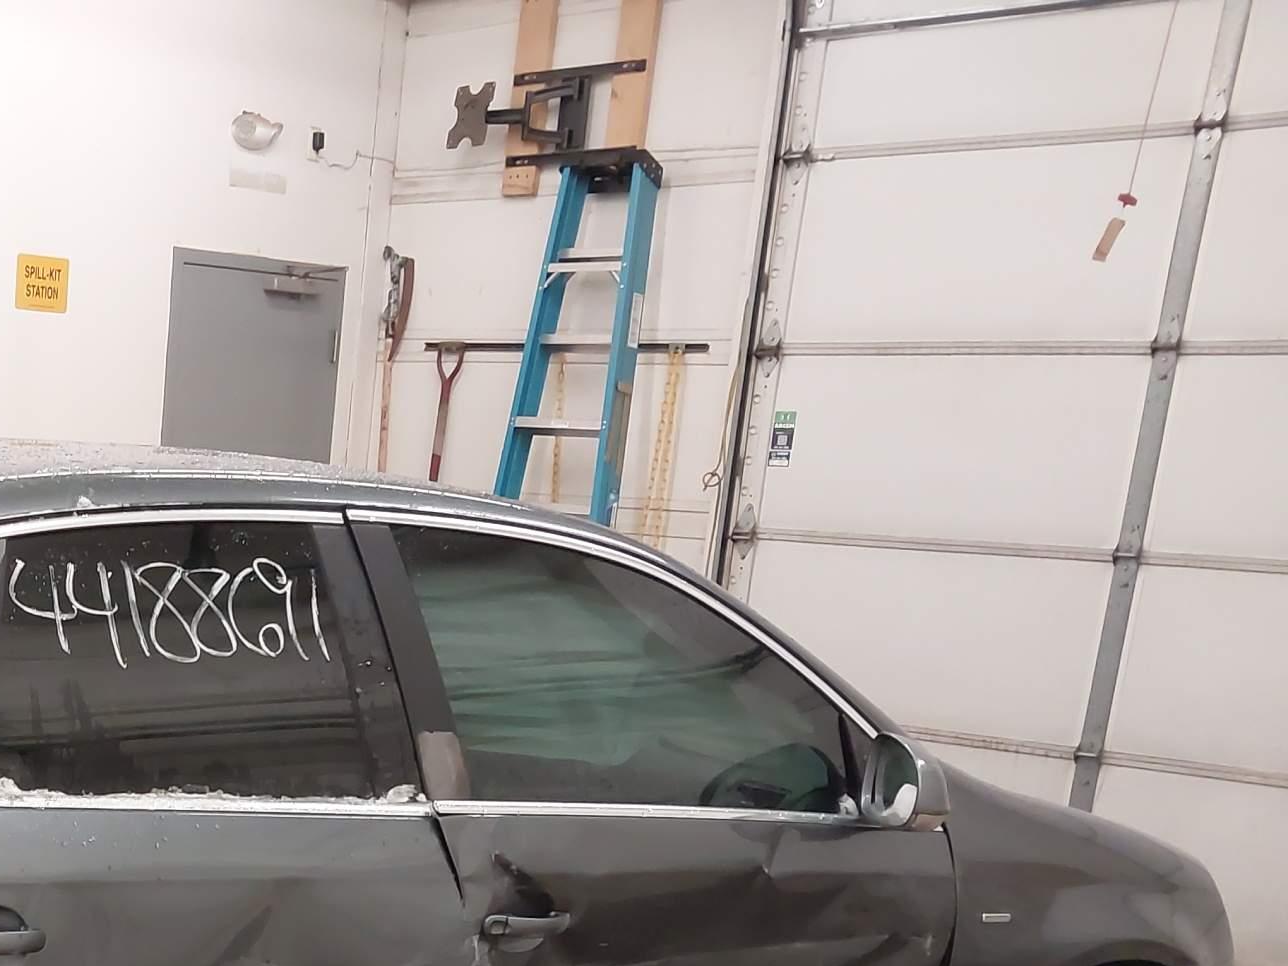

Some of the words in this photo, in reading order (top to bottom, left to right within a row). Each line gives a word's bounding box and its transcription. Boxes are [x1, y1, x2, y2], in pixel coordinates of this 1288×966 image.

[24, 264, 62, 282] SPILL-KIT
[25, 283, 59, 300] STATION
[9, 557, 331, 669] 44188691
